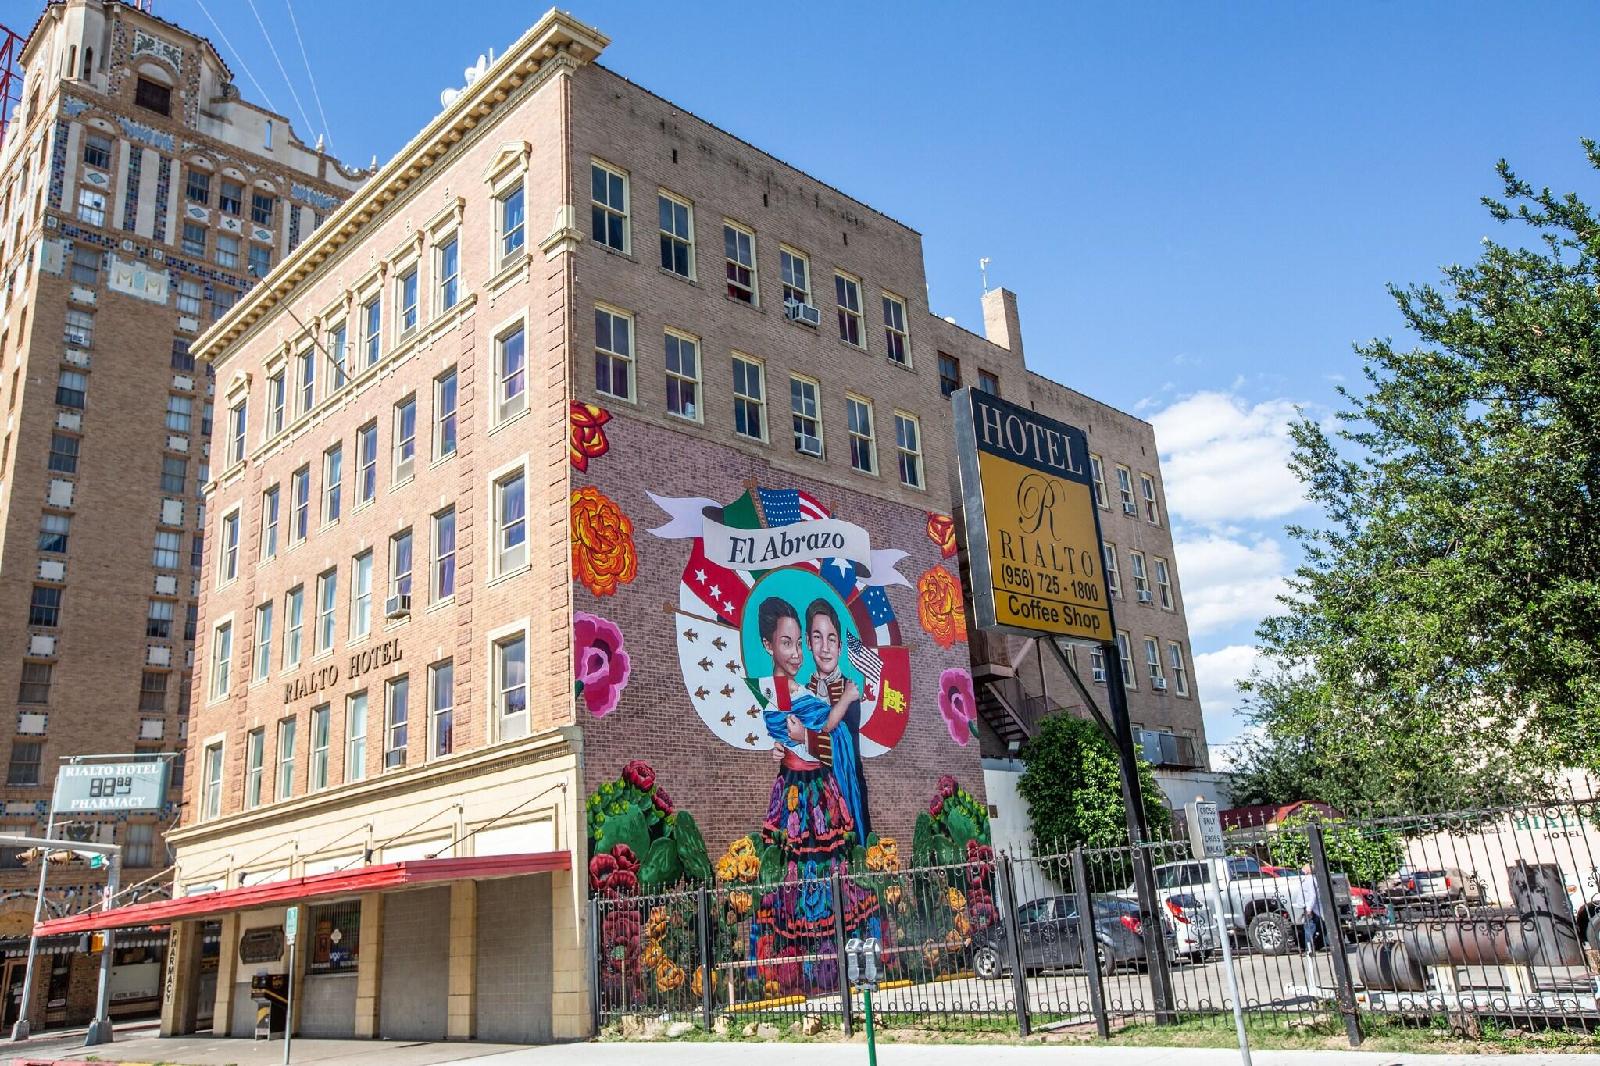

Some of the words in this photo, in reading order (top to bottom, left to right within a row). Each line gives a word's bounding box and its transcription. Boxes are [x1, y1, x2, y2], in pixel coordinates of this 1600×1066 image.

[978, 402, 1083, 475] HOTEL
[1017, 473, 1066, 542] R
[728, 536, 755, 564] El
[760, 531, 845, 562] Abrazo
[998, 528, 1094, 578] RIALTO
[1001, 563, 1034, 594] (956)
[1008, 592, 1060, 623] Coffee
[1063, 605, 1101, 630] Shop
[283, 664, 339, 704] RIALTO
[348, 638, 403, 679] HOTEL
[65, 765, 113, 777] RIALTO
[116, 764, 160, 775] HOTEL
[71, 797, 146, 809] PHARMACY
[1515, 815, 1584, 831] RIAL
[1543, 830, 1583, 841] HOTEL
[166, 929, 178, 1003] PHARMACY
